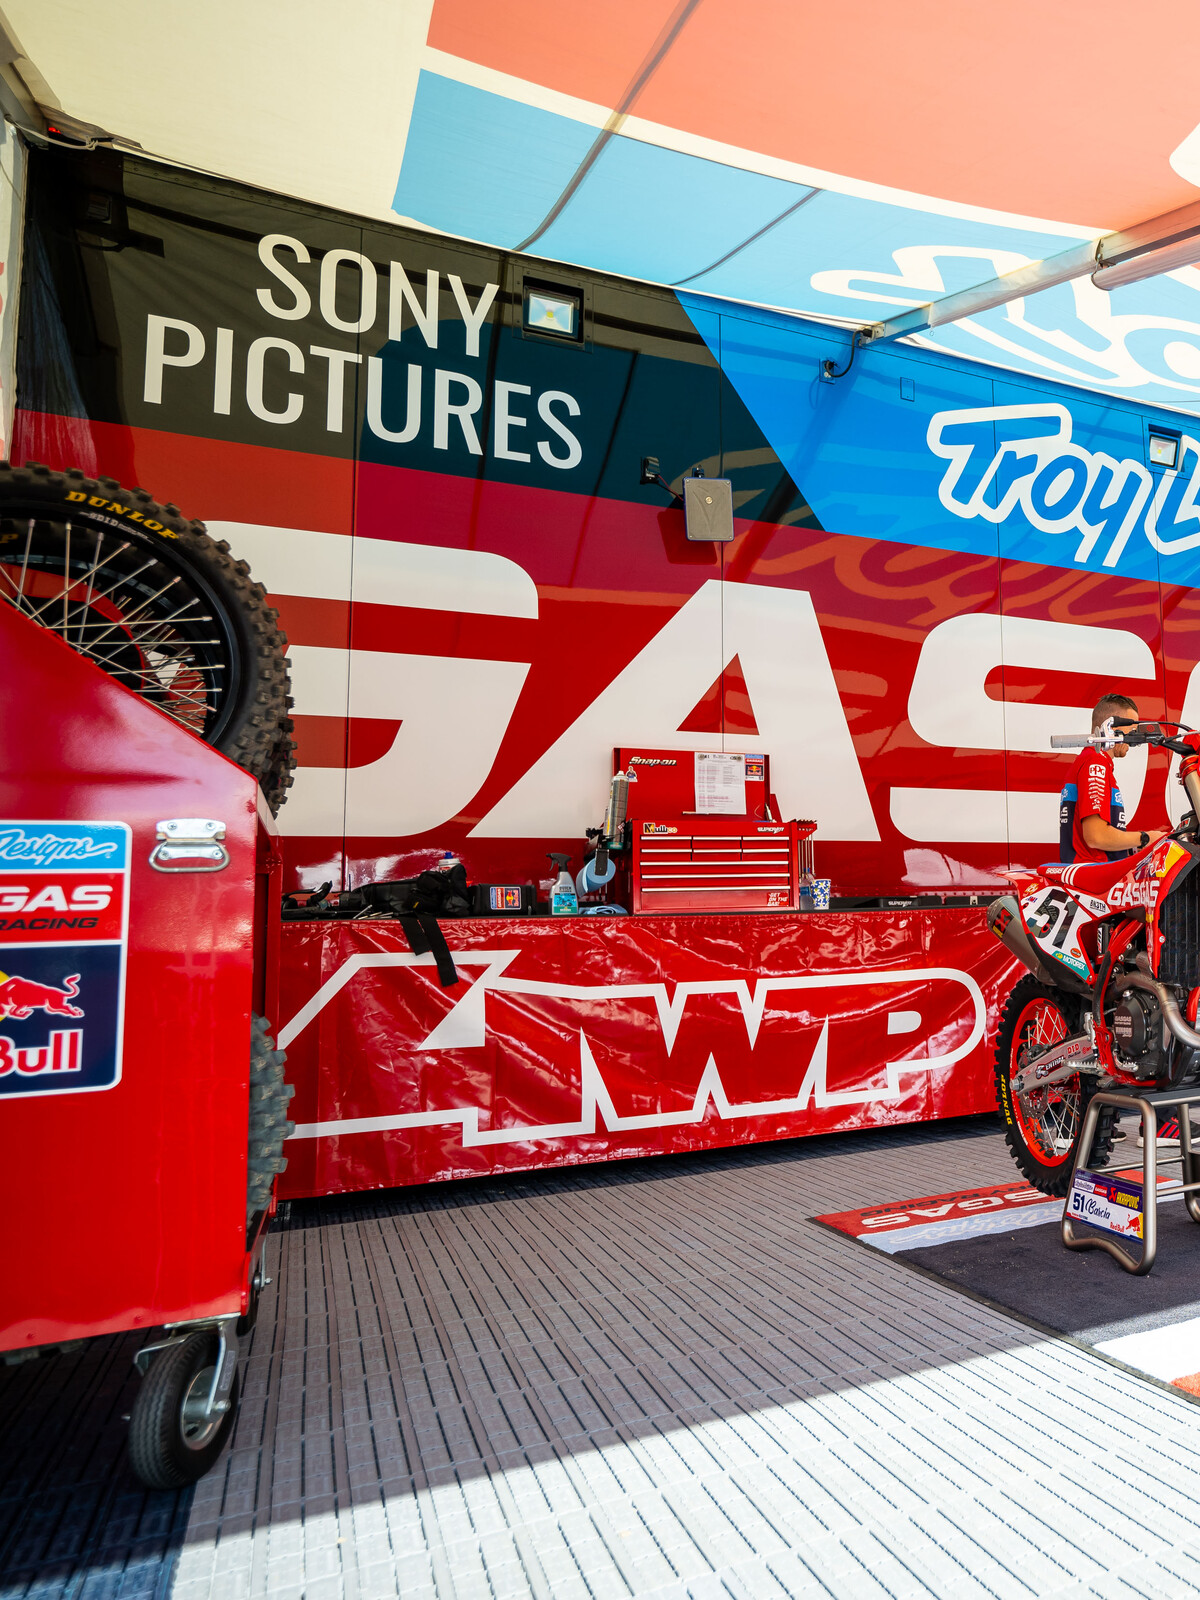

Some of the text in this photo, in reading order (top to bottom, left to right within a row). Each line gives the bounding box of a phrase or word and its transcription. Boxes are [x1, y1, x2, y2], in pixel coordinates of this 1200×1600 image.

[256, 233, 500, 357] SONY
[142, 314, 583, 470] PICTURES
[927, 402, 1154, 568] Troy
[65, 490, 179, 539] DUNLOP
[629, 757, 677, 766] Snap-on
[1107, 880, 1160, 907] GASGAS
[1027, 889, 1080, 949] 51
[1063, 955, 1085, 971] MOTOREX
[1067, 1044, 1080, 1054] DID
[1001, 1074, 1013, 1125] DUNLOP
[860, 1194, 981, 1218] RACING
[861, 1189, 1049, 1229] SGAS
[1073, 1193, 1085, 1212] 51
[1086, 1198, 1111, 1219] Barcia
